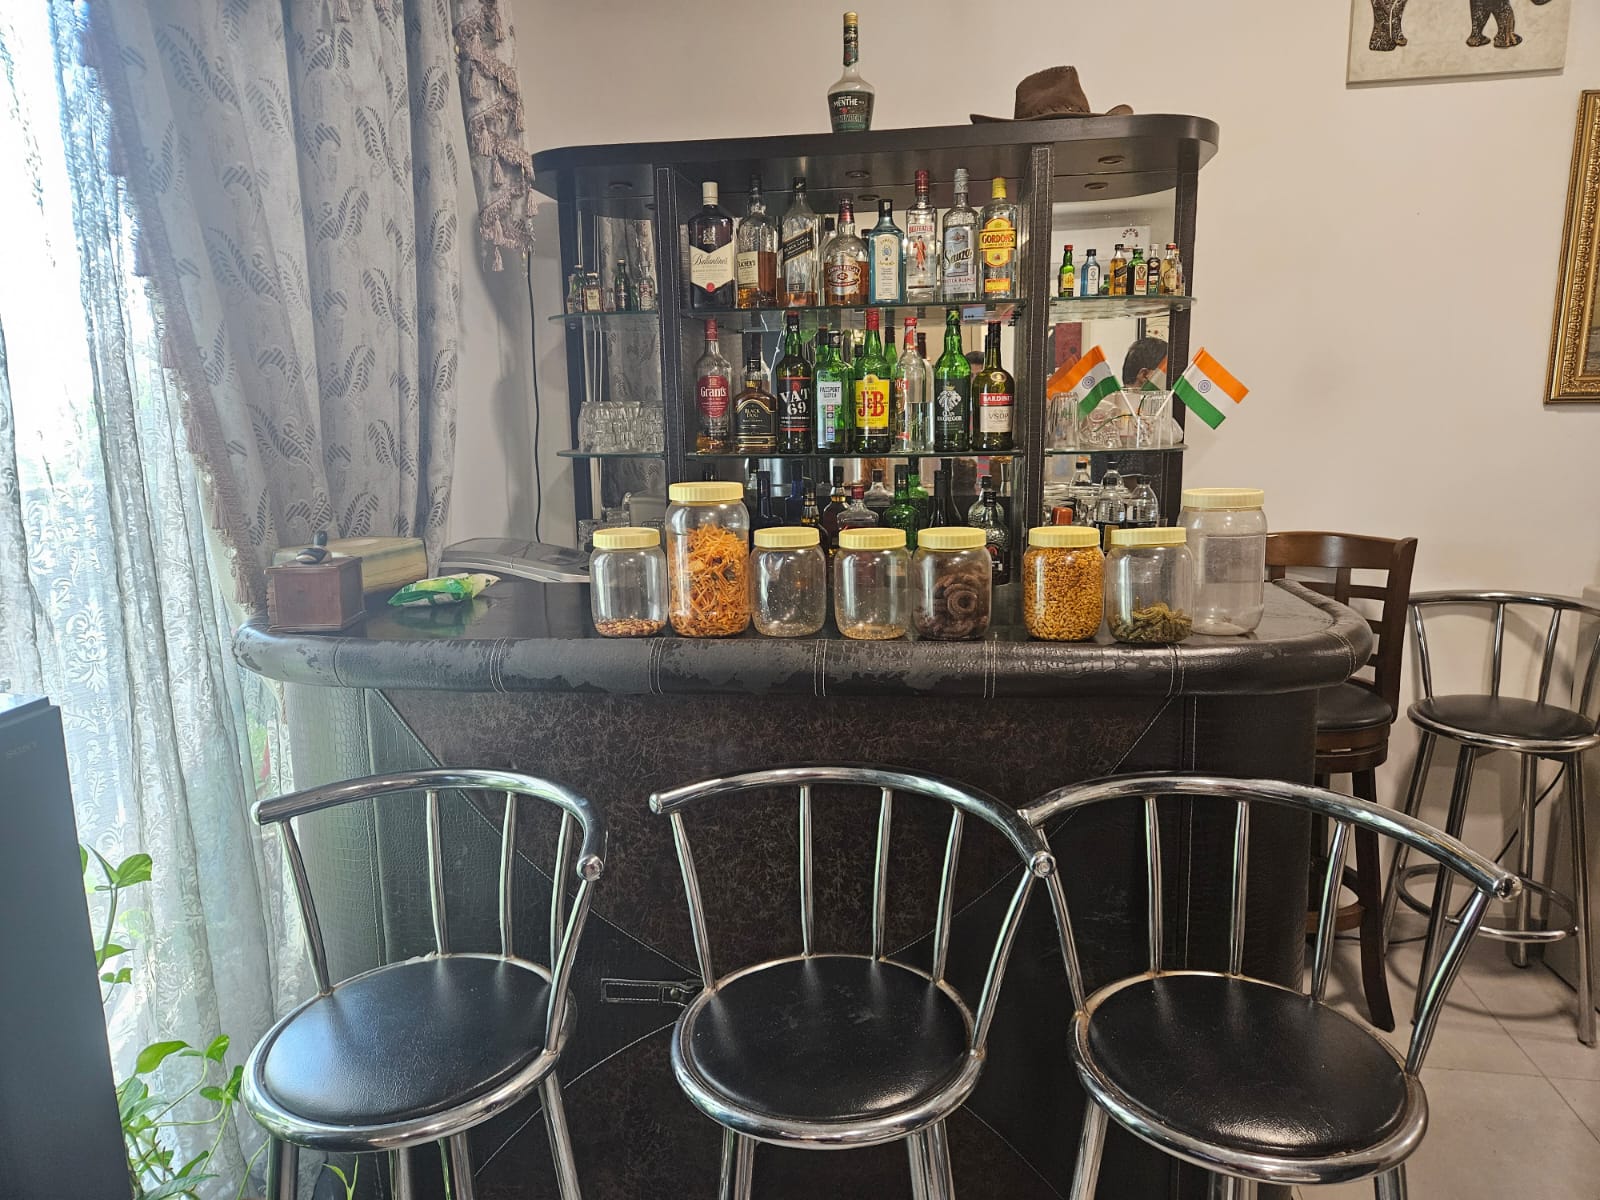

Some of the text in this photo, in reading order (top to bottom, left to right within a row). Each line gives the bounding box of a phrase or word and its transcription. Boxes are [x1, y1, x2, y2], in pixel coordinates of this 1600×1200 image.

[834, 98, 859, 107] MENTHE
[779, 388, 809, 403] VAT
[858, 390, 885, 417] J&B
